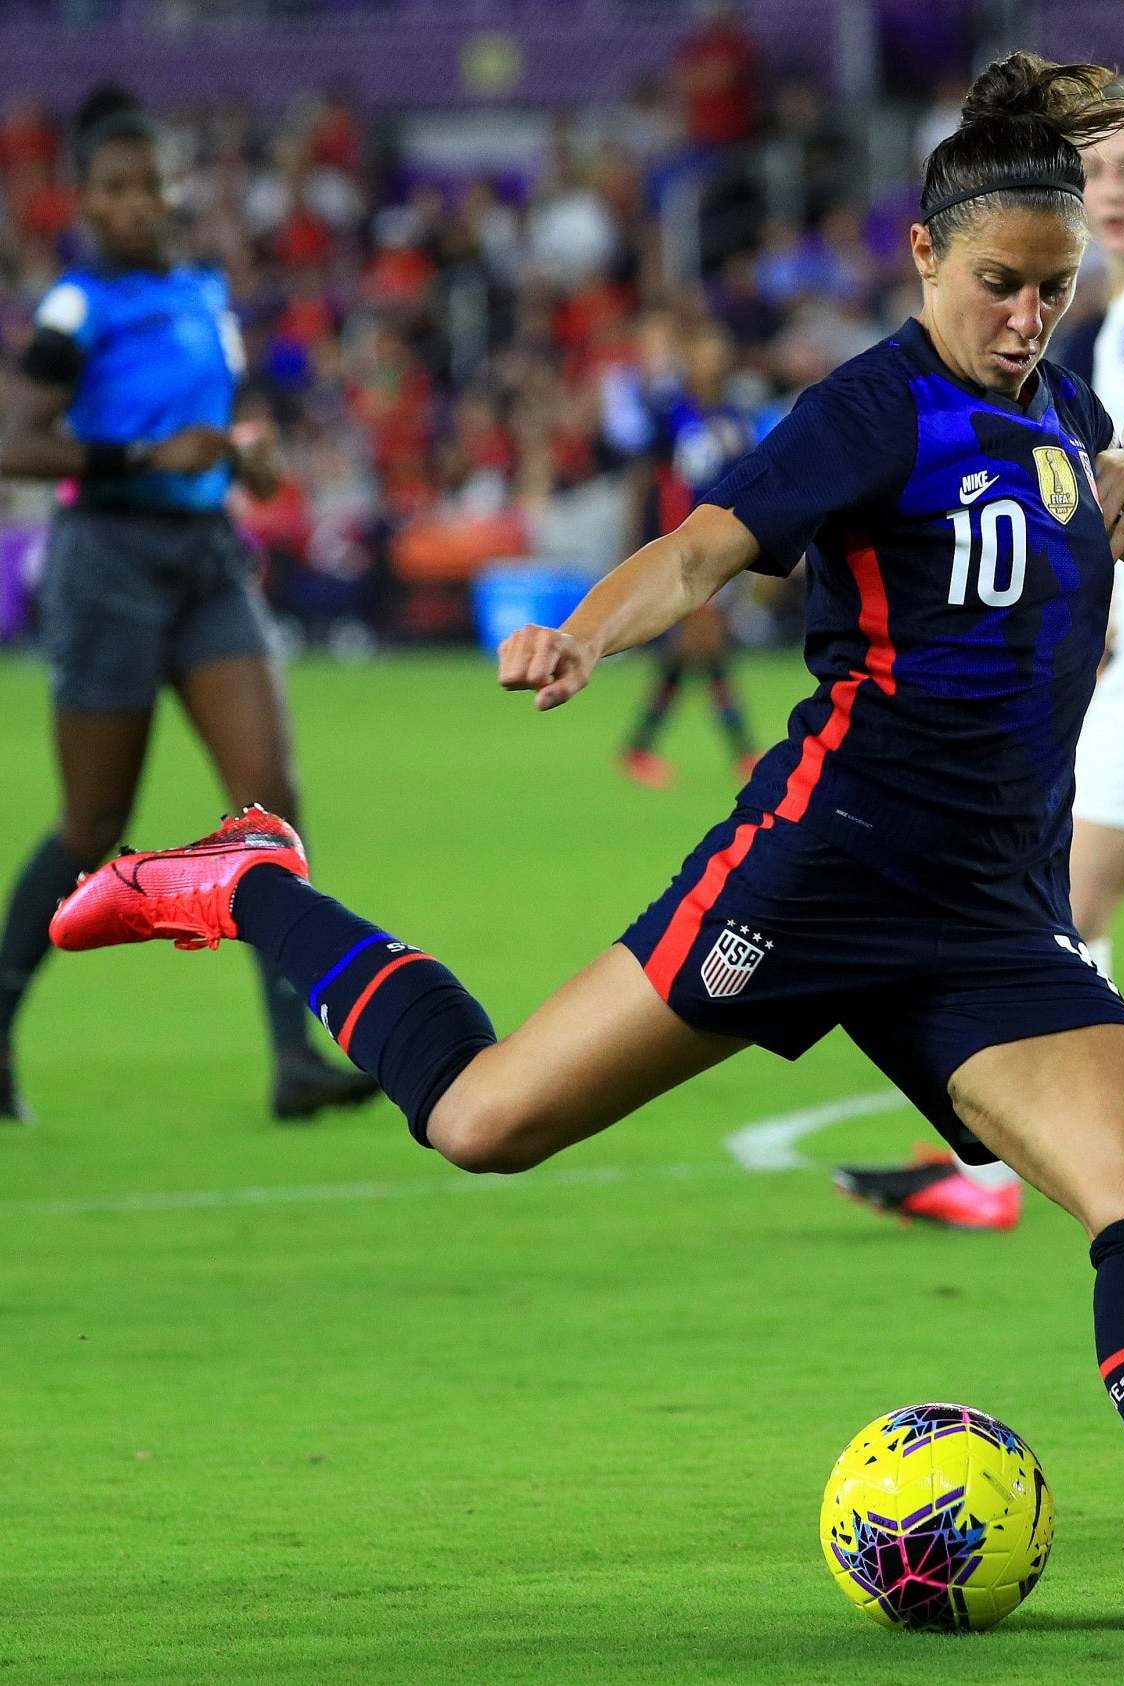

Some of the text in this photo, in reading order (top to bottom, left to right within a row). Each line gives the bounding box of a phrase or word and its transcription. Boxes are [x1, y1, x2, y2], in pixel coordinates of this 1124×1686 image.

[962, 470, 988, 493] NIKE
[1051, 494, 1069, 504] FIFA
[946, 499, 1027, 607] 10
[719, 933, 761, 968] USA
